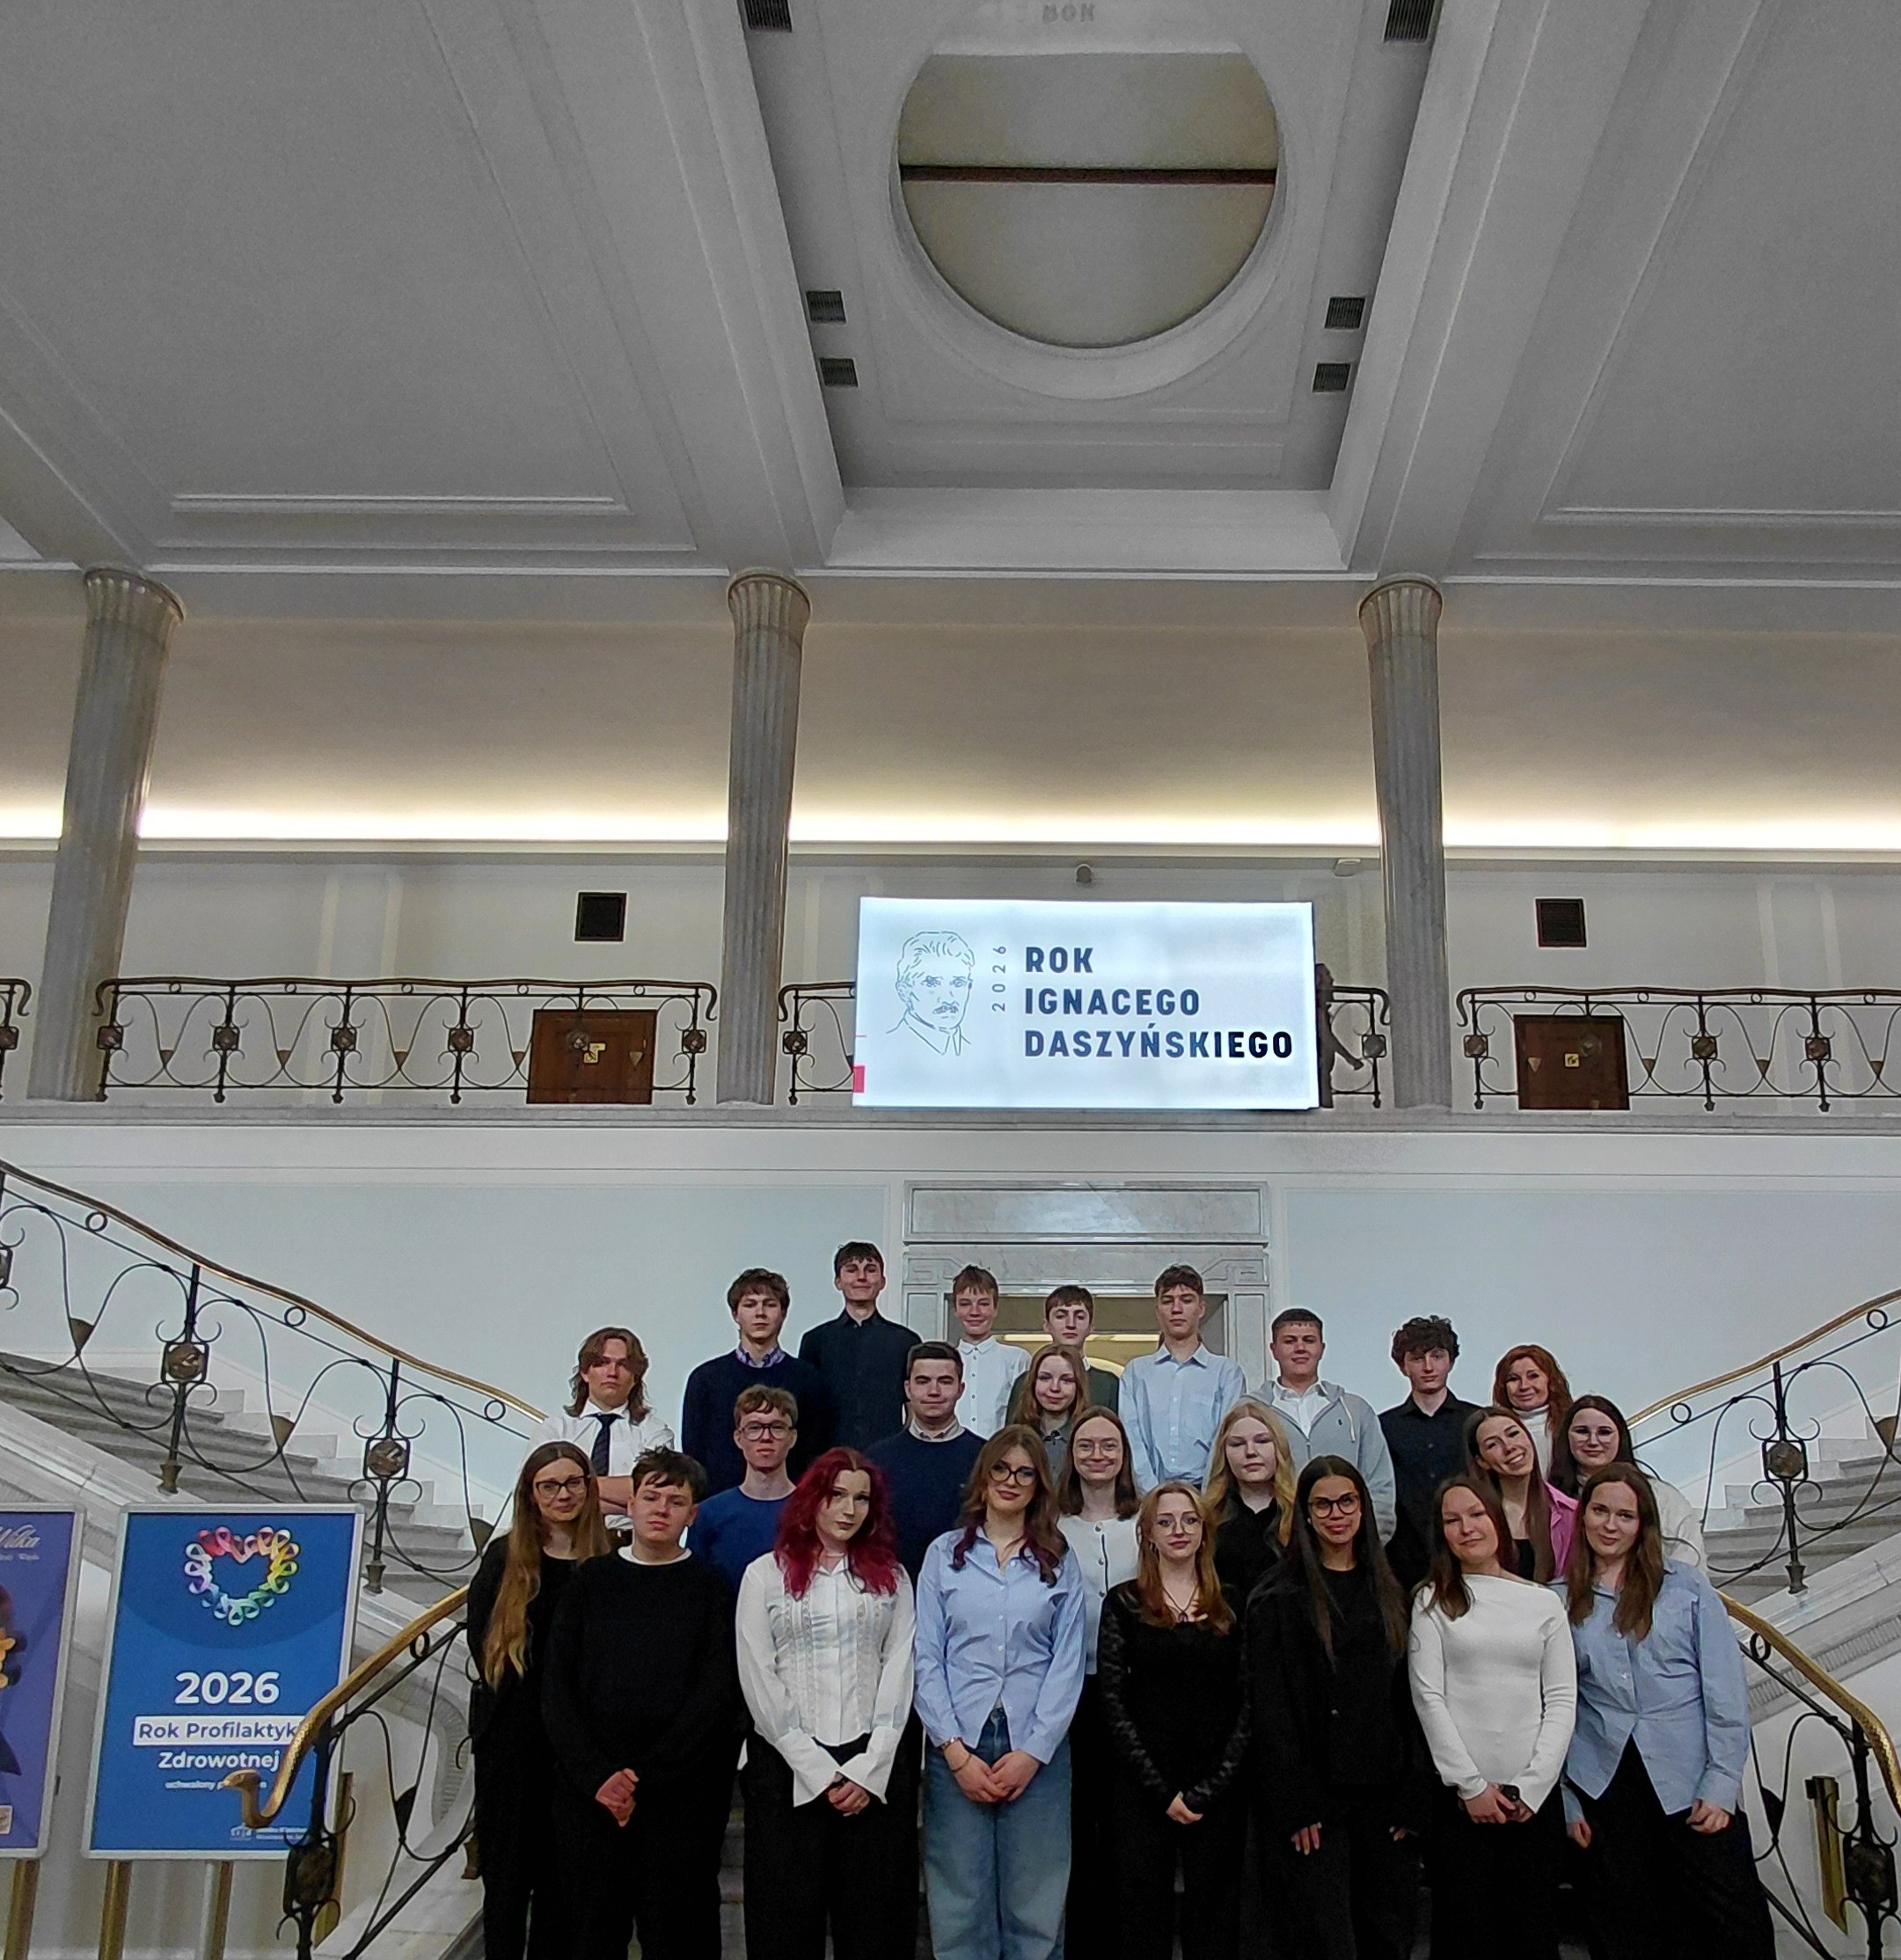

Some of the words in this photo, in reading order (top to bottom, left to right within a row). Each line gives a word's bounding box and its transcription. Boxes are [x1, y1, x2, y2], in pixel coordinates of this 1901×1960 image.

[1026, 947, 1093, 973] ROK
[991, 946, 1006, 1012] 2026
[1025, 988, 1200, 1015] IGNACEGO
[1025, 1023, 1293, 1058] DASZYŃSKIEGO
[175, 1671, 280, 1704] 2026
[139, 1722, 179, 1738] Rok
[186, 1722, 298, 1741] Profilaktyk
[158, 1750, 281, 1772] Zdrowotnej
